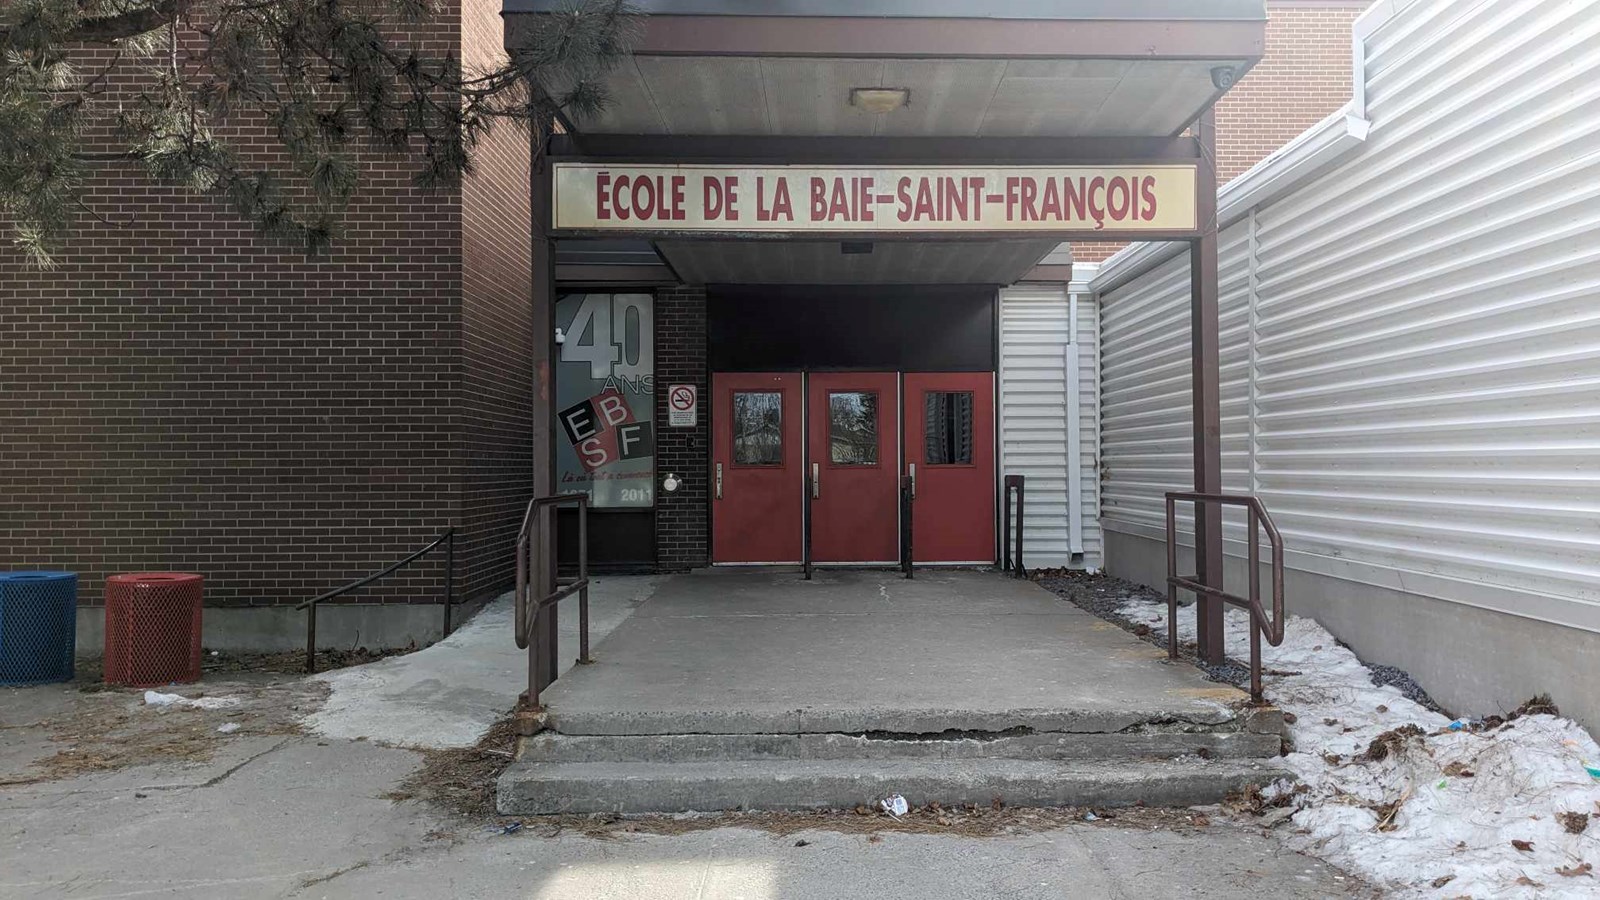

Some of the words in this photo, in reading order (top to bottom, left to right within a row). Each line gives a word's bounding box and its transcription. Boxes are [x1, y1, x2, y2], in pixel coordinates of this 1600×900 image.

[596, 171, 686, 221] ÉCOLE
[703, 175, 739, 221] DE
[756, 176, 795, 222] LA
[810, 175, 1157, 230] BAIE-SAINT-FRANÇOIS
[561, 293, 653, 382] 40
[601, 374, 654, 395] ANS
[621, 488, 652, 502] 2011
